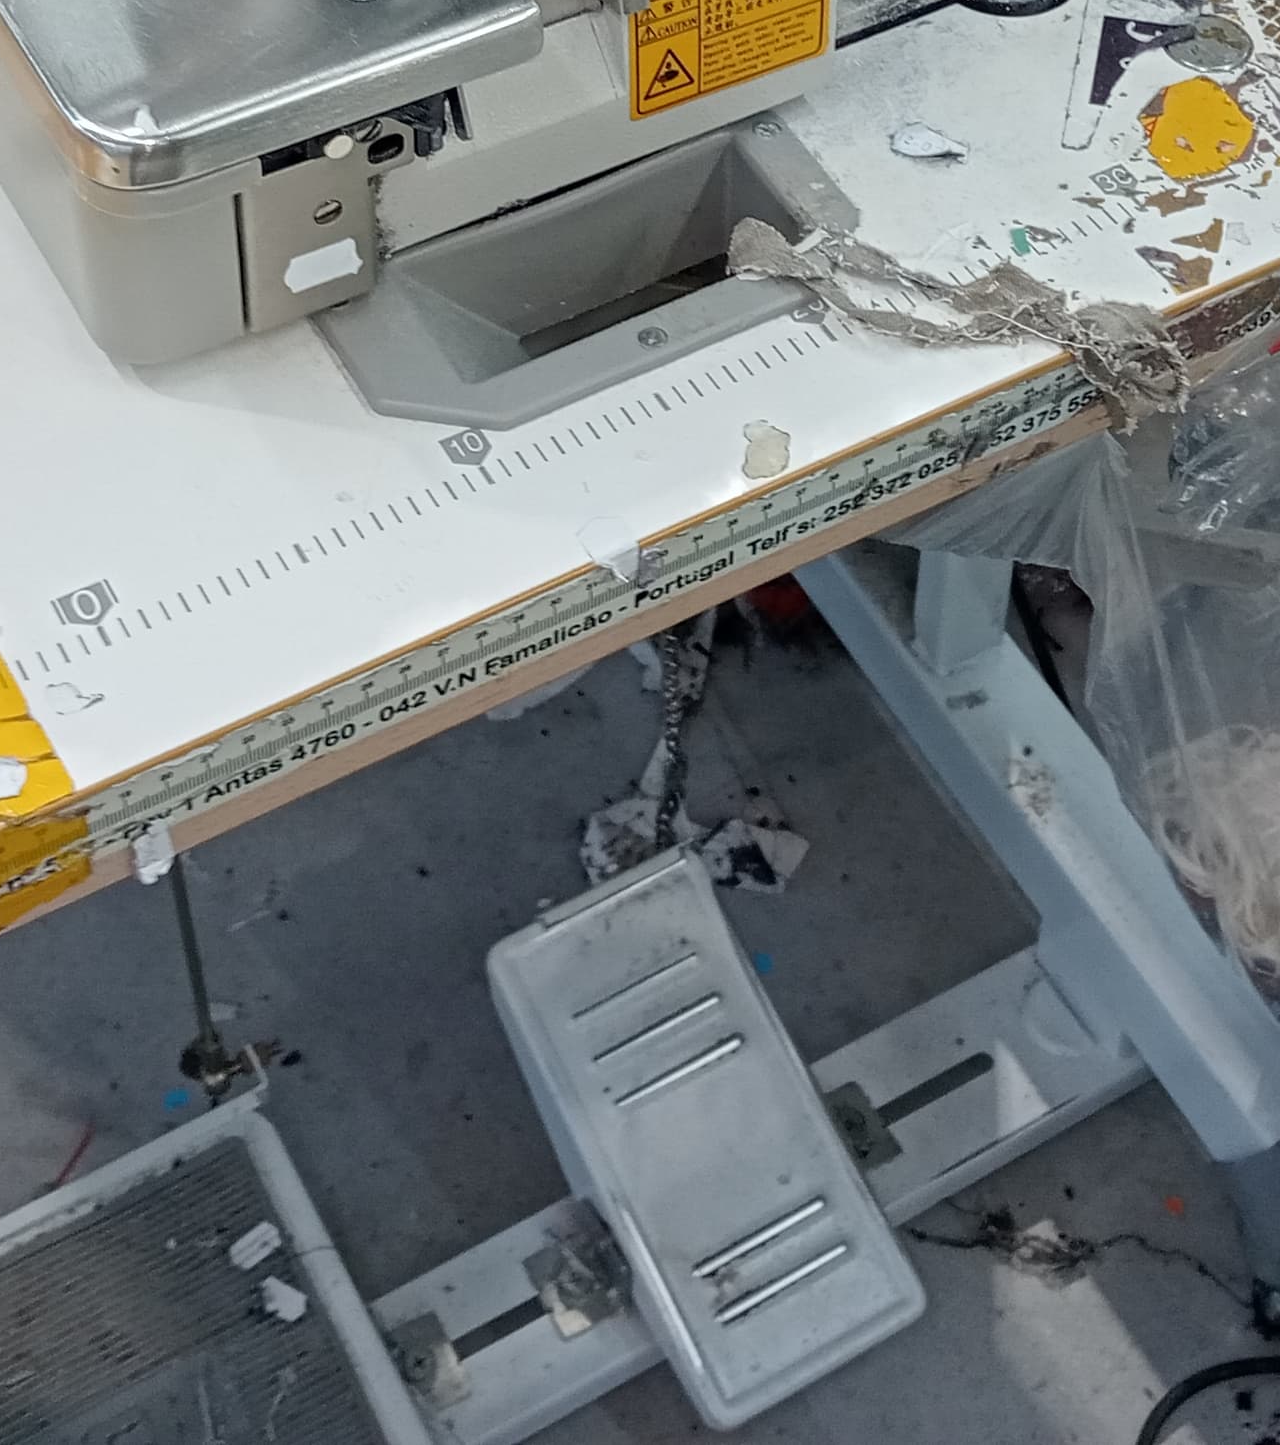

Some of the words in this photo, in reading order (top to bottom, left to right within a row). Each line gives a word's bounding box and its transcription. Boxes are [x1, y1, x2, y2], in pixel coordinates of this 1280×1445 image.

[658, 18, 698, 38] CAUTION
[449, 431, 484, 457] 10
[71, 589, 102, 621] 0
[204, 758, 283, 804] Antas
[290, 723, 356, 761] 4760
[379, 689, 428, 723] 042
[433, 667, 476, 697] V.N
[485, 607, 613, 676] Famalicão
[633, 551, 735, 609] Portugal
[871, 473, 913, 501] 372
[917, 451, 959, 480] 025
[1021, 406, 1062, 432] 375
